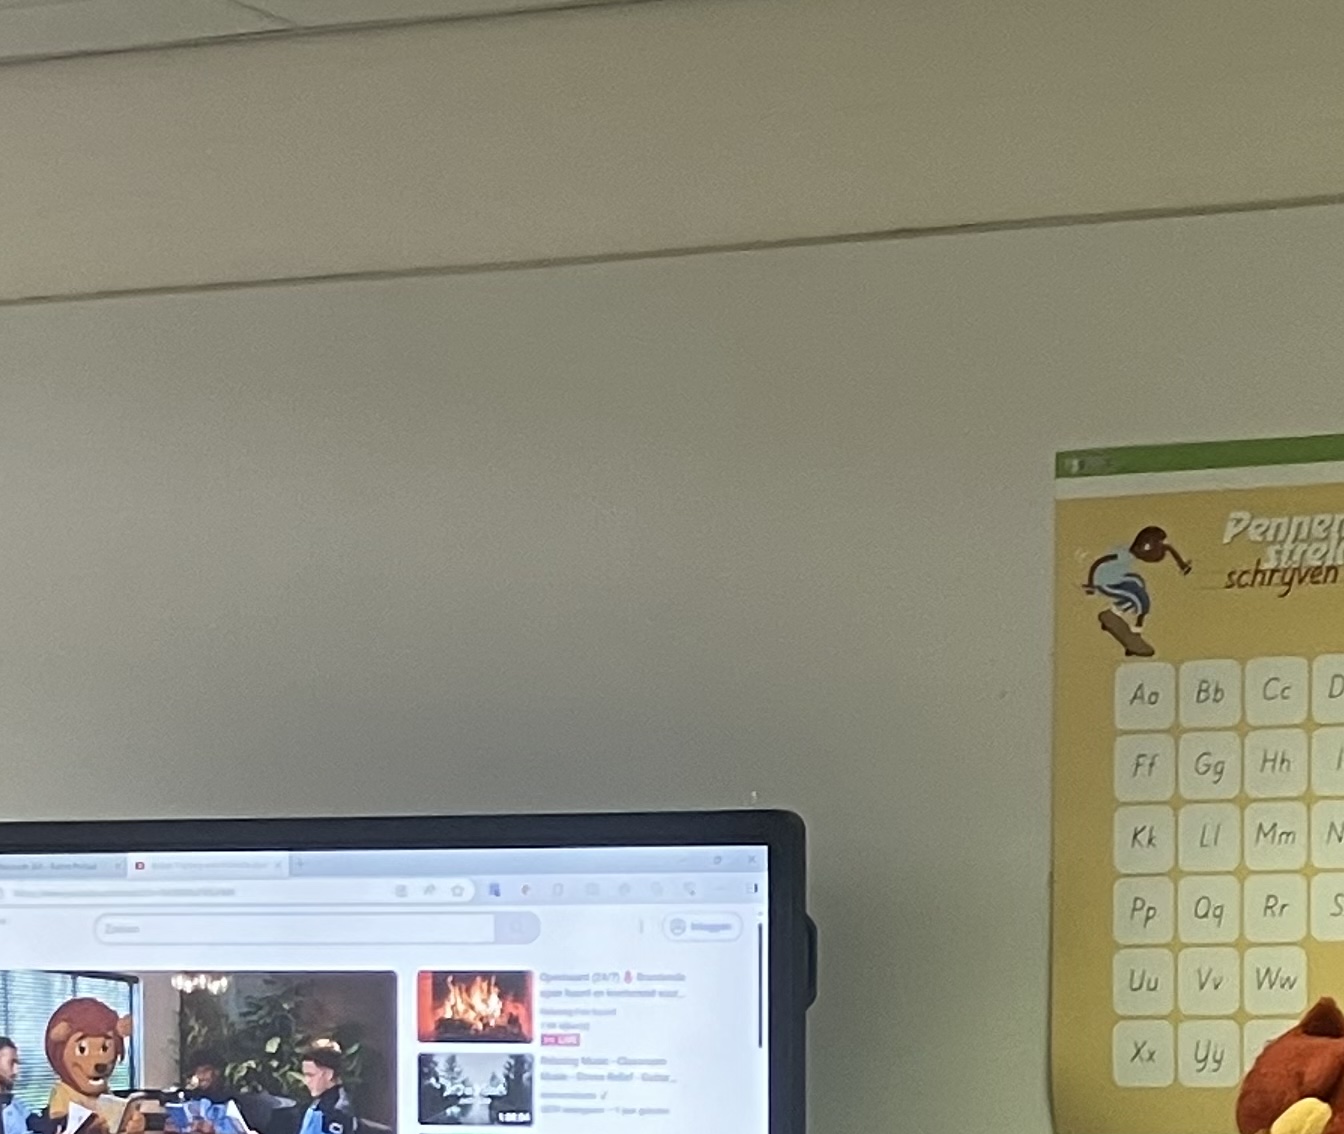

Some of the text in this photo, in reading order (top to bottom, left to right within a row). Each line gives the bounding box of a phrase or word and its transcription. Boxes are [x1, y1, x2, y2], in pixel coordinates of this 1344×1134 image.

[1130, 683, 1159, 707] Aa
[1195, 679, 1224, 704] Bb
[1263, 677, 1291, 701] Cc
[1132, 753, 1160, 778] Ff
[1194, 751, 1225, 784] Gg
[1260, 749, 1291, 772] Hh
[1131, 826, 1156, 848] Kk
[1256, 822, 1296, 846] Mm
[1130, 897, 1156, 927] Pp
[1194, 896, 1224, 927] Qq
[1263, 895, 1289, 918] Rr
[1130, 968, 1297, 991] Uu Vv Ww
[1131, 1039, 1224, 1072] Xx Yy
